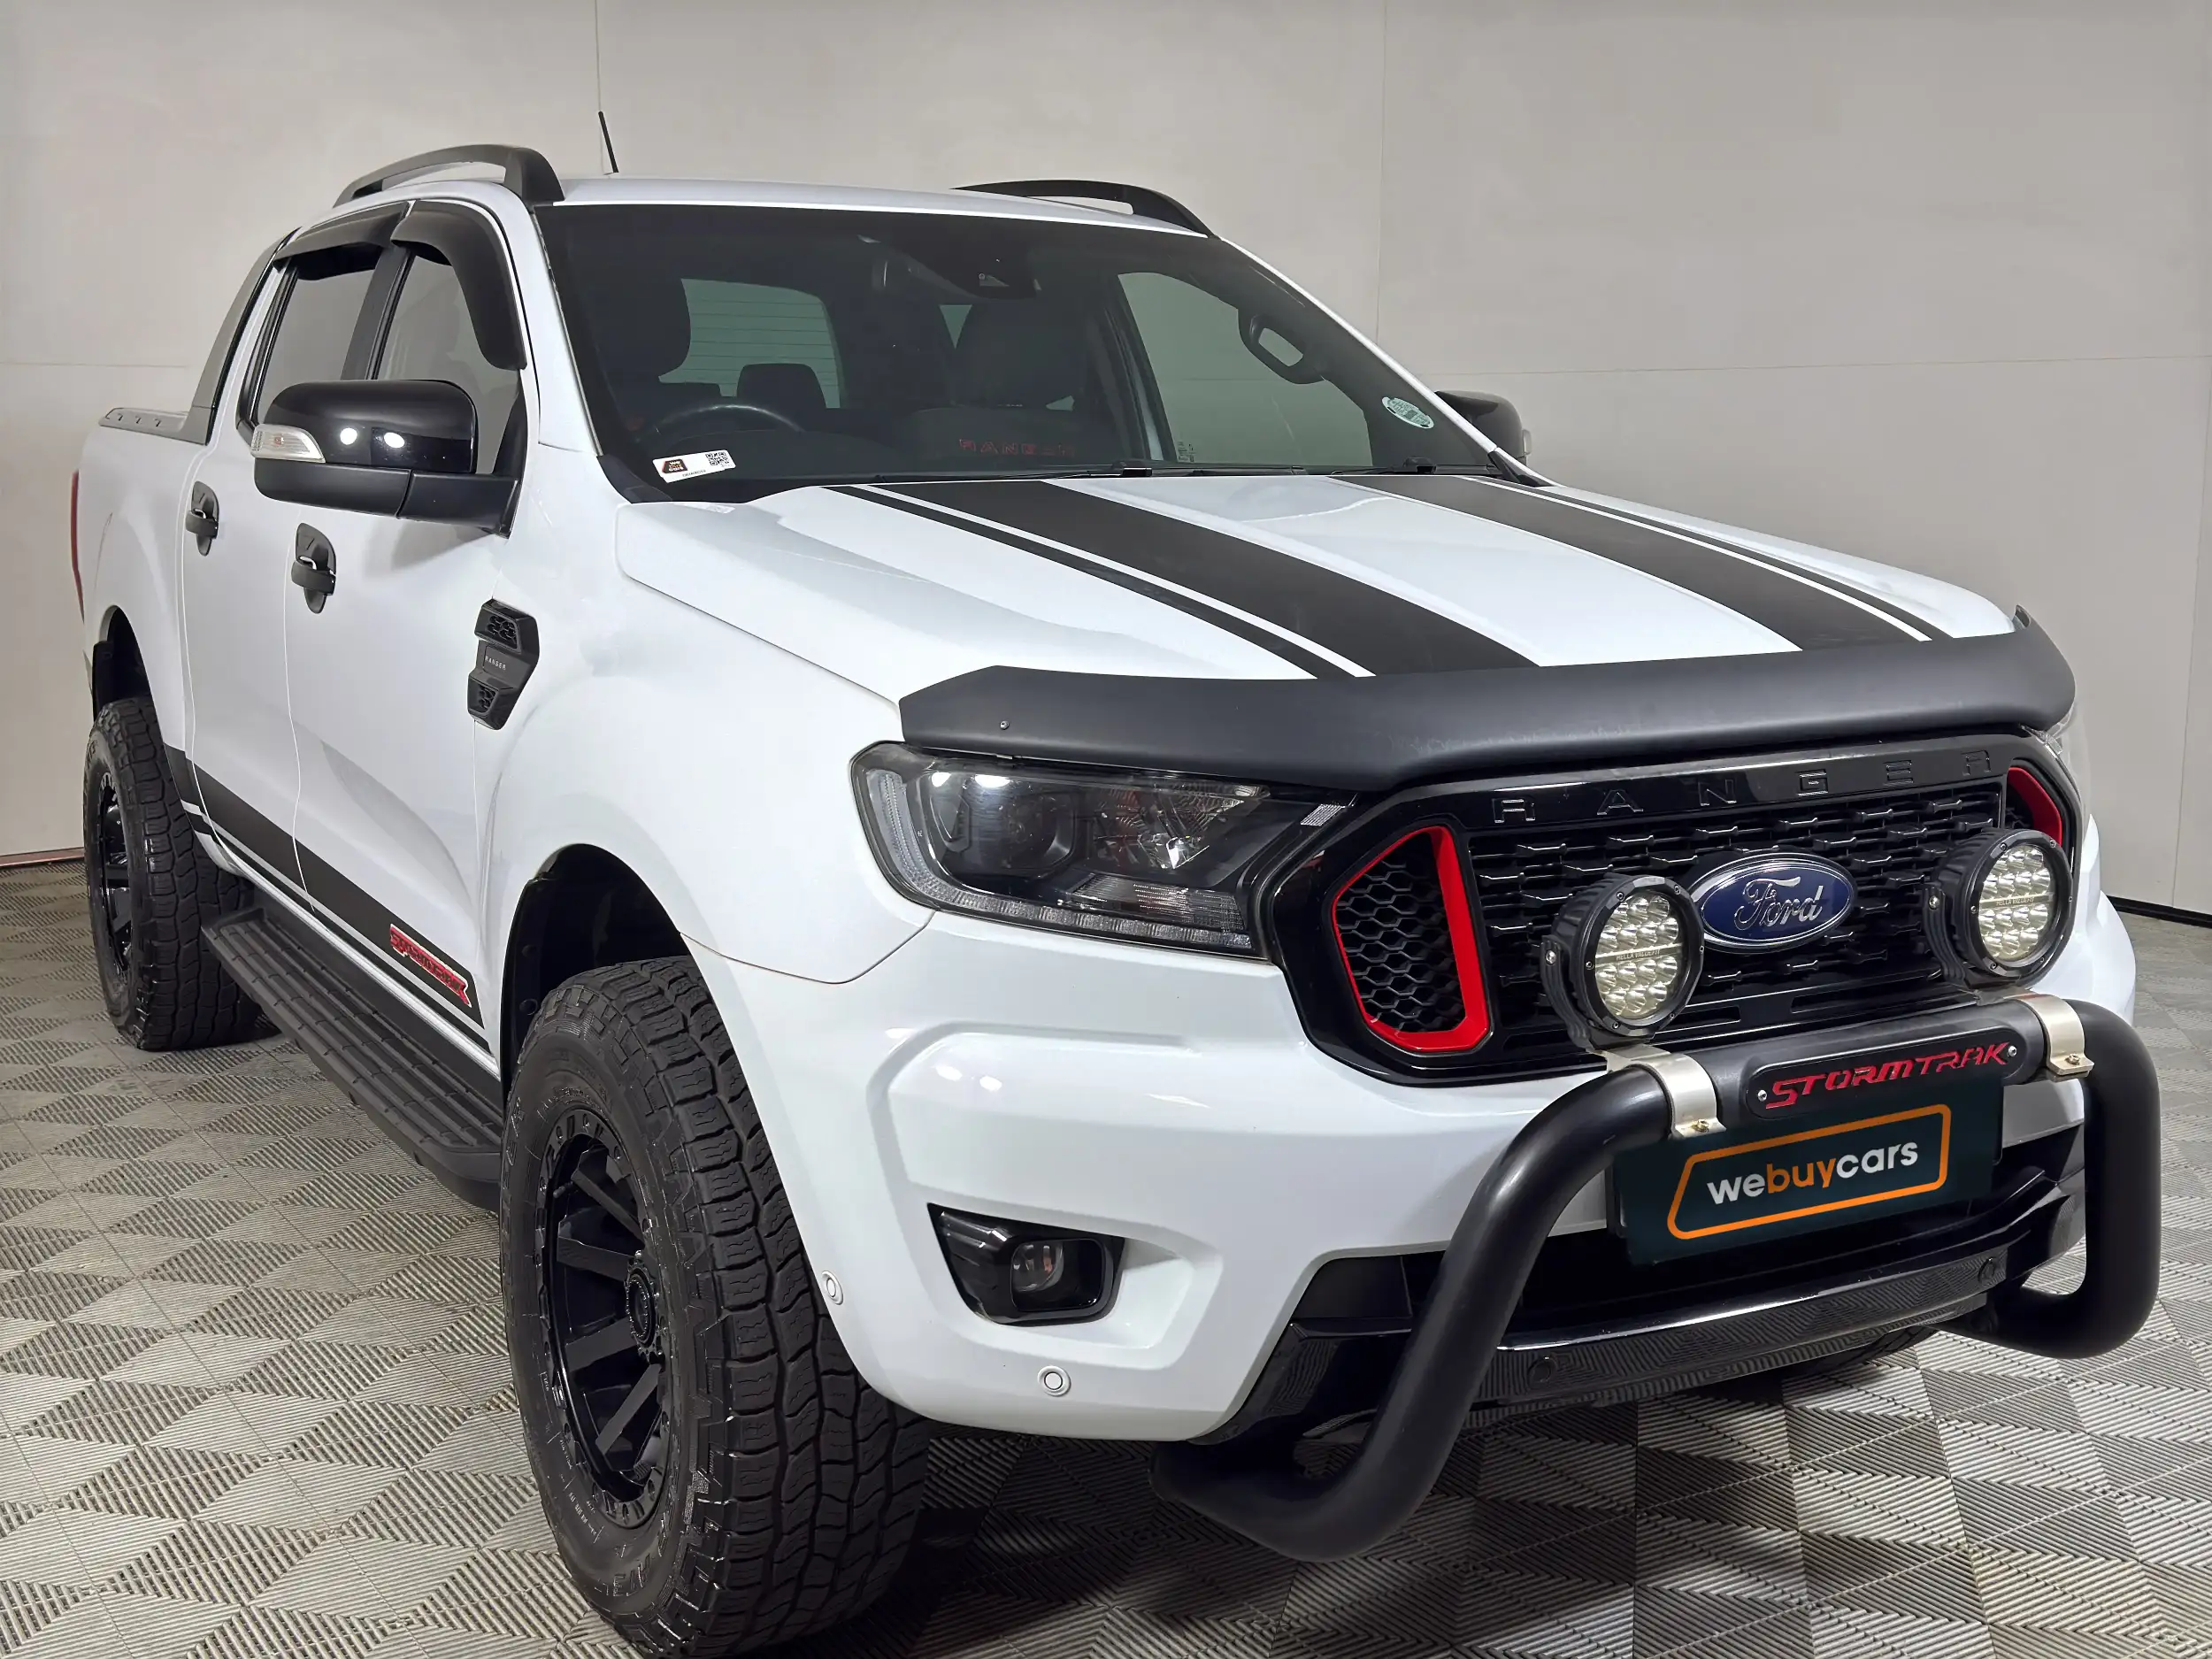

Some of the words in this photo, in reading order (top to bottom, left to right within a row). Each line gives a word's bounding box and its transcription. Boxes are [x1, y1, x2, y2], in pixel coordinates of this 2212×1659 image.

[485, 655, 507, 671] RANGER
[1493, 749, 1993, 824] RANGER
[1733, 875, 1824, 929] Ford
[1765, 1041, 2011, 1110] STORMTRAK
